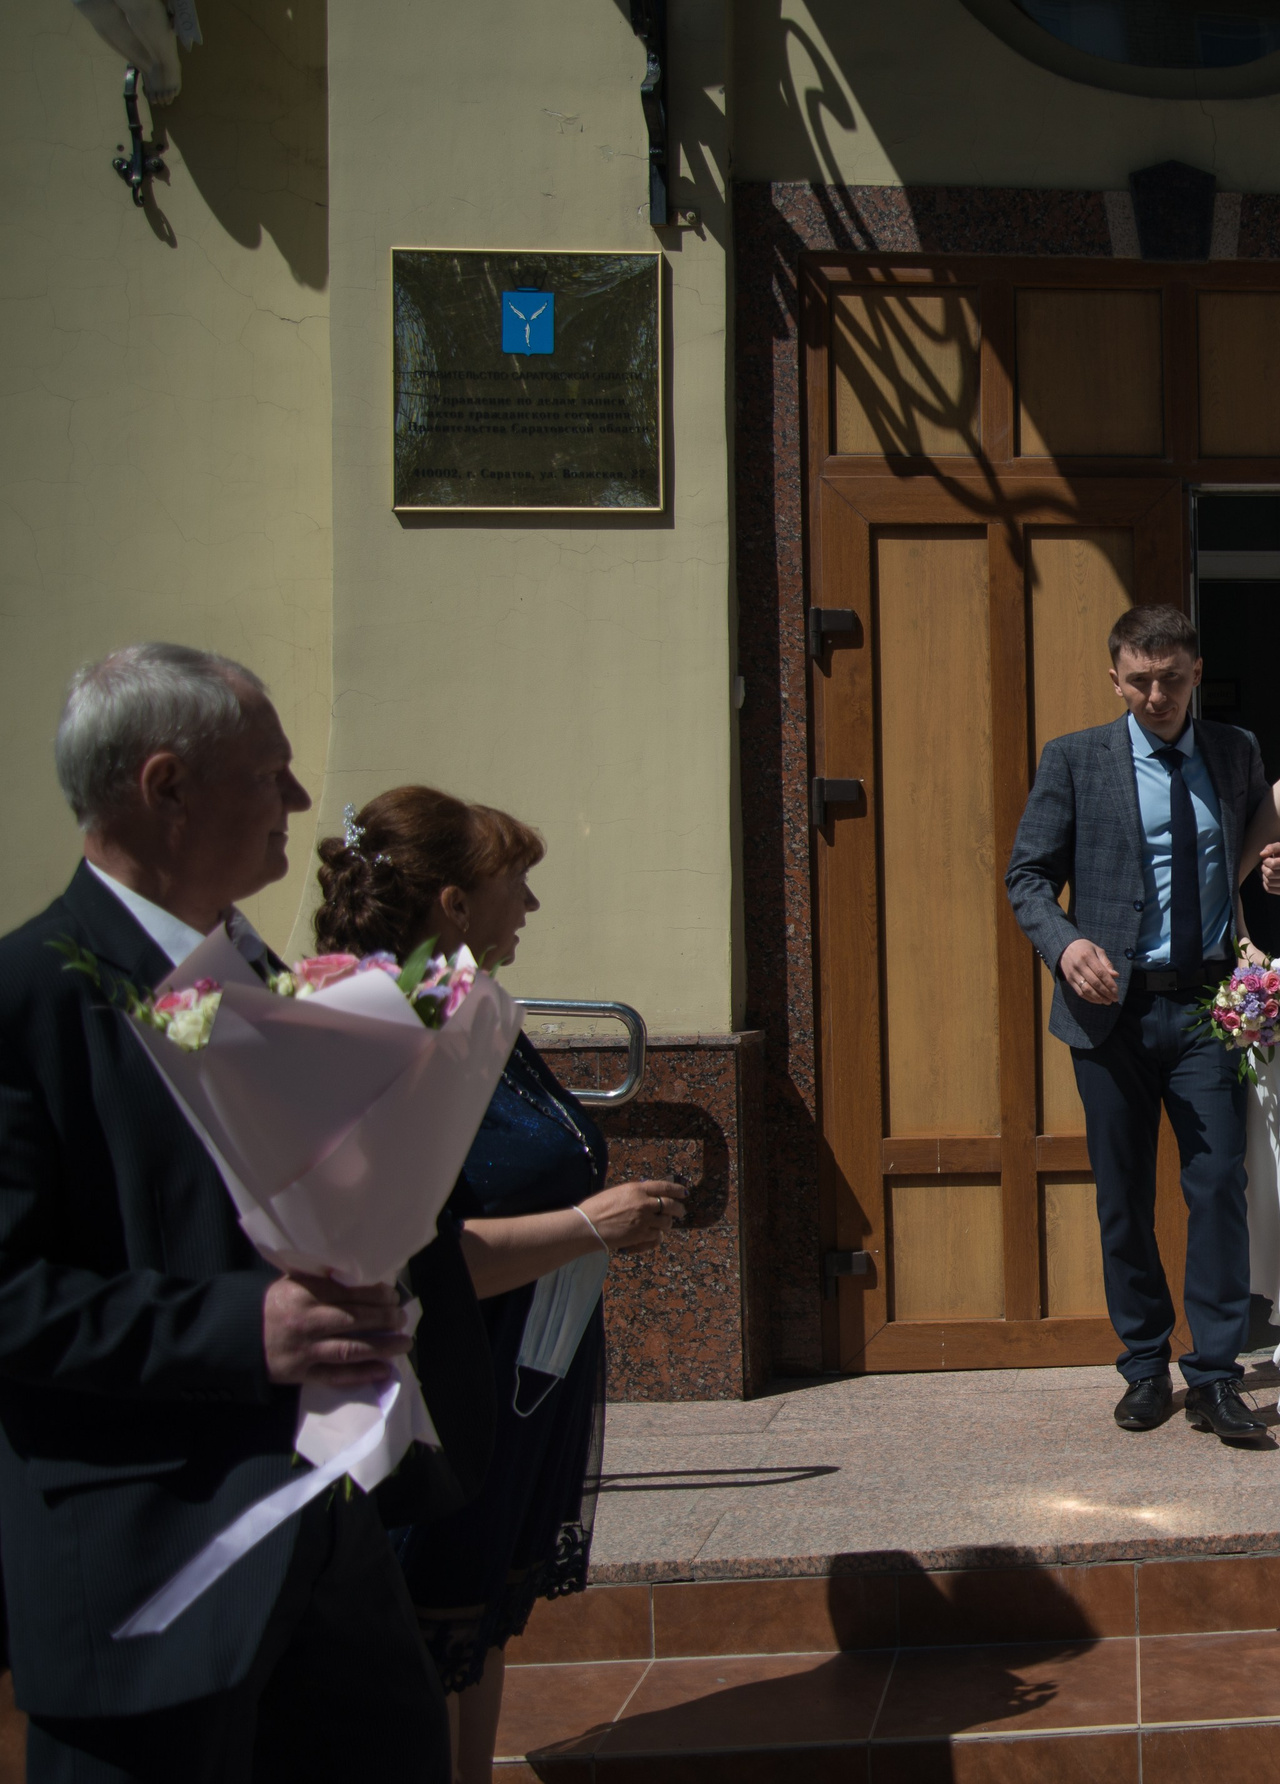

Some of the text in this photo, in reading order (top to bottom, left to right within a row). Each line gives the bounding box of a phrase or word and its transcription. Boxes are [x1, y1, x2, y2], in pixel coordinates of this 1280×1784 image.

[414, 370, 510, 381] ПРАВИТЕЛЬСТВО
[511, 370, 591, 381] САРАТОВСКОЙ
[432, 394, 626, 408] Управление по делам записи
[427, 410, 631, 422] актов гражданского состояния
[408, 421, 649, 437] Правительства Саратовской области
[467, 471, 477, 479] г.
[480, 468, 535, 481] Саратов,
[540, 471, 557, 481] ул.
[563, 468, 627, 480] Волжская,
